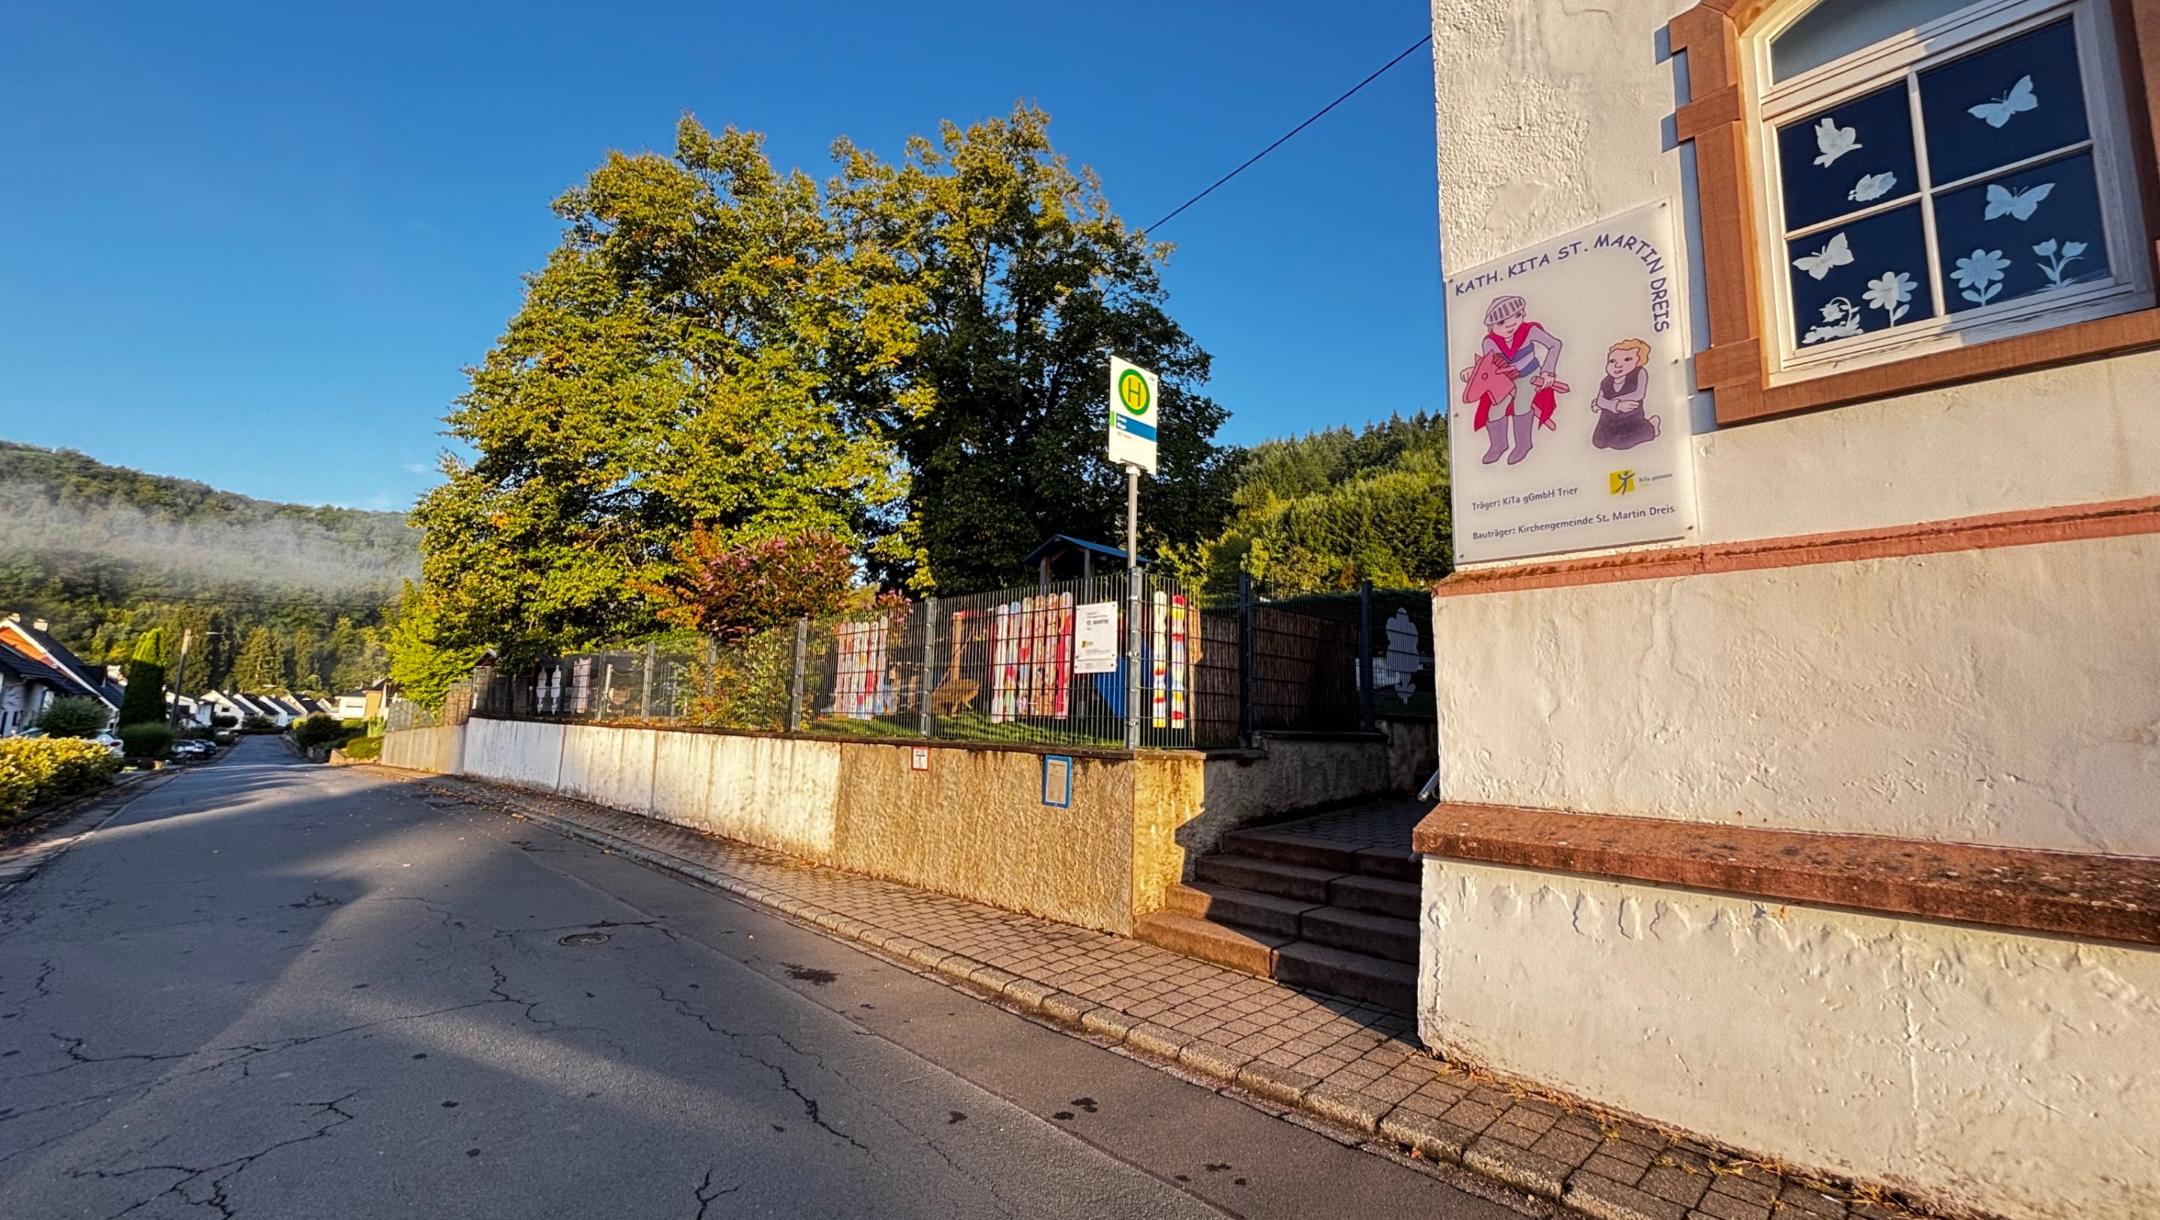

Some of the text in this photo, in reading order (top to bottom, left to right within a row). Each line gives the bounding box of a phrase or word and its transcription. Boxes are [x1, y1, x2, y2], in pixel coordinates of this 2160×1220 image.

[1455, 233, 1669, 333] KATH. KITA ST. MARTIN DREIS
[1128, 377, 1141, 407] H
[1472, 487, 1578, 511] Träger: KiTa gGmbH Trier
[1473, 505, 1675, 540] Bauträger: Kirchengemeinde St. Martin Dreis
